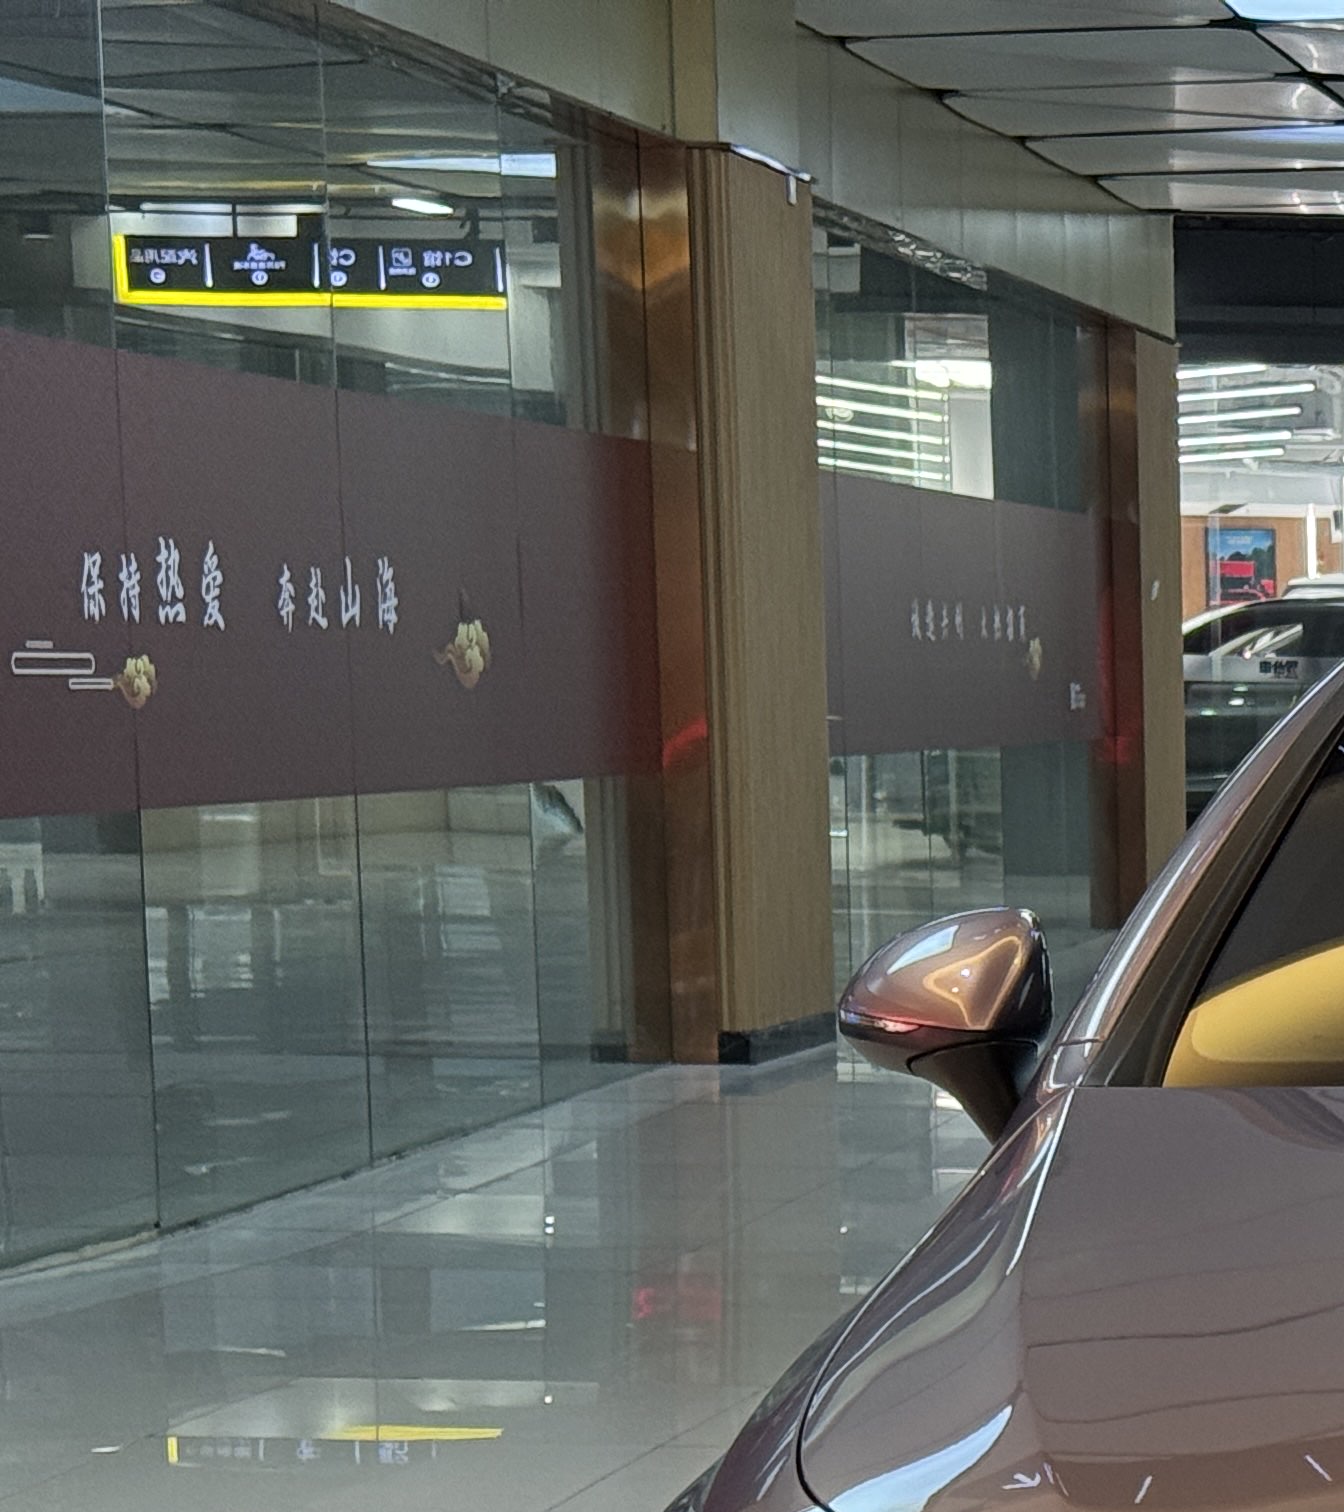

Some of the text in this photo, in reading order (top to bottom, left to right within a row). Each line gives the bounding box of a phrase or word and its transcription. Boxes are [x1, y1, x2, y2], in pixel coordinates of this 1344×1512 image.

[81, 536, 399, 635] 保持热爱 奔赴山海
